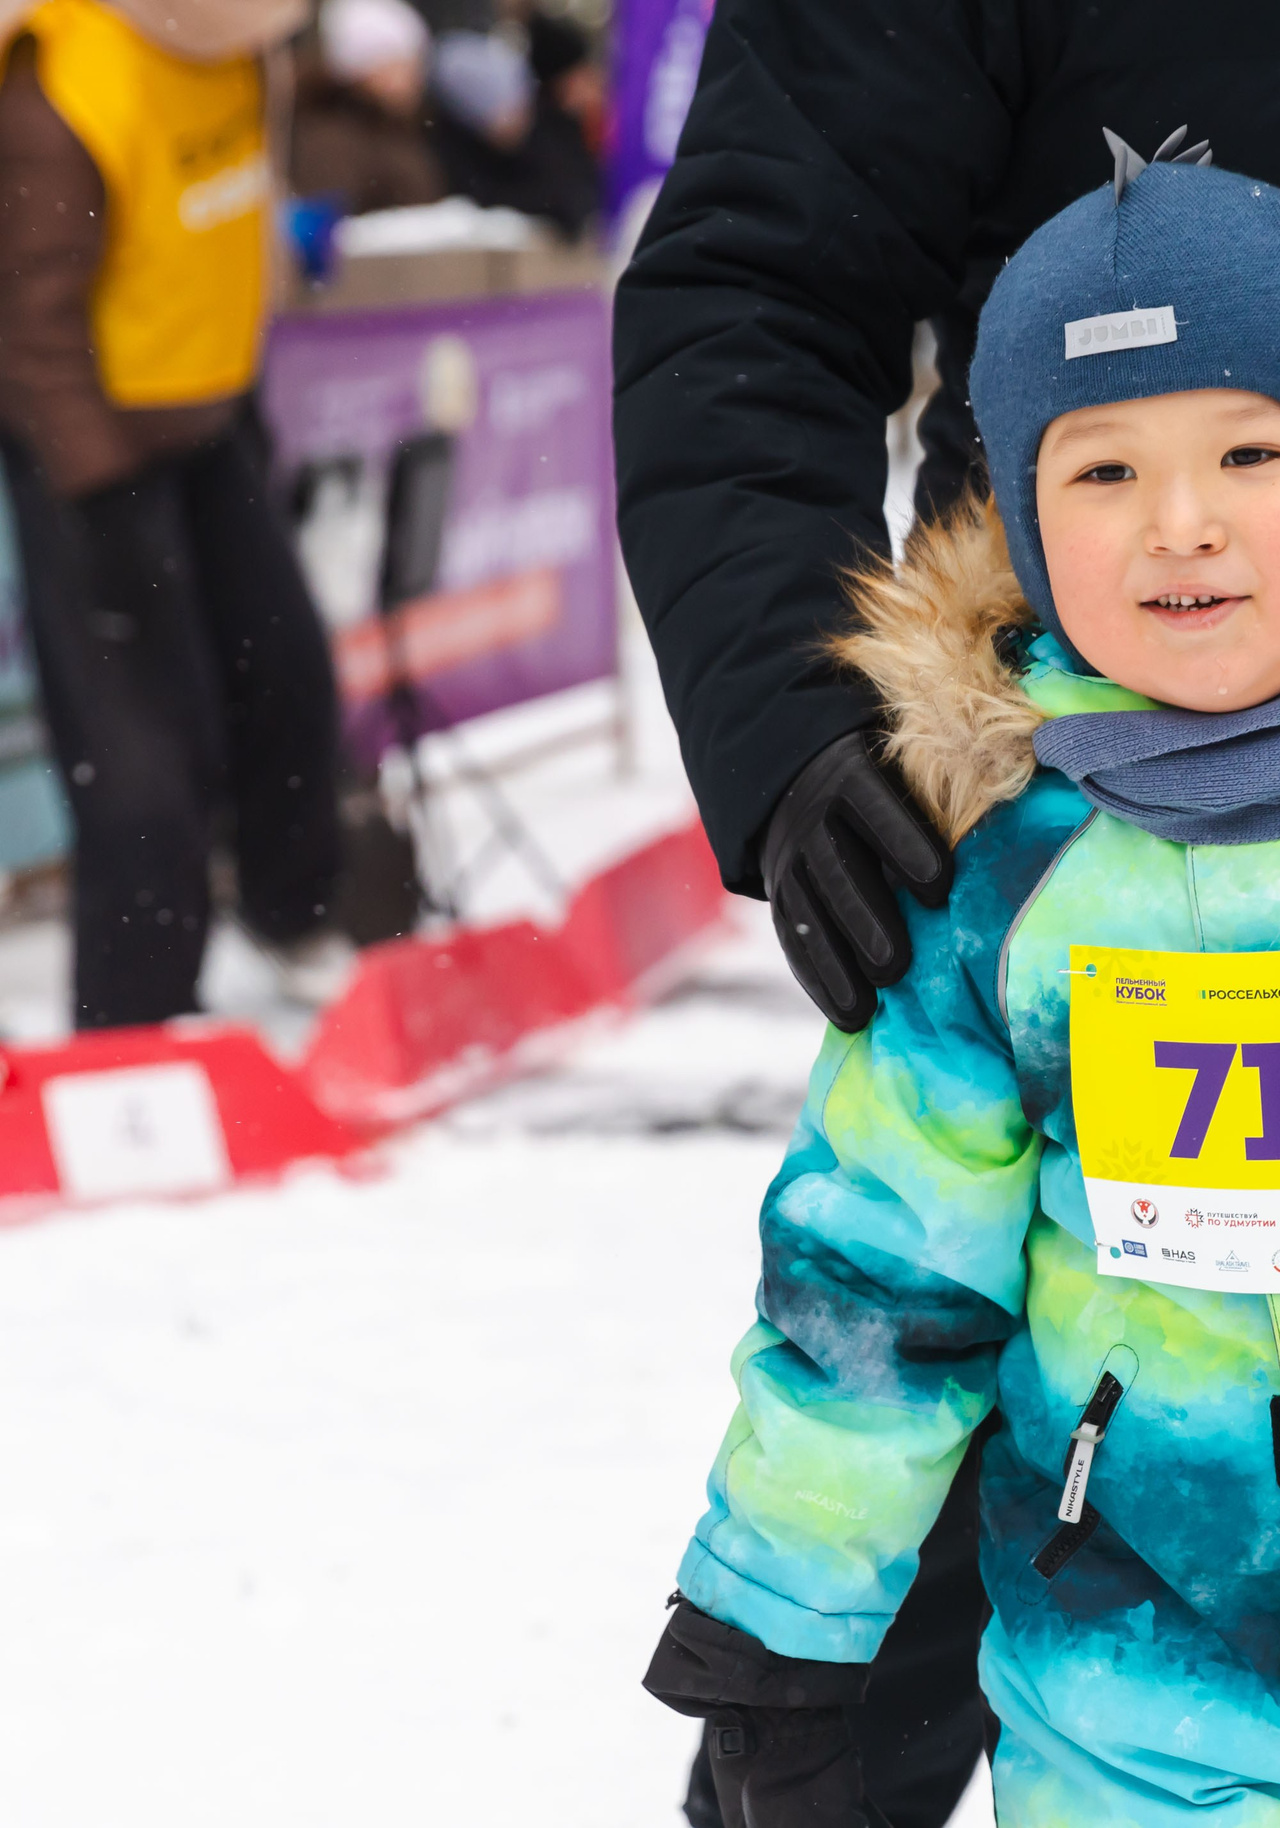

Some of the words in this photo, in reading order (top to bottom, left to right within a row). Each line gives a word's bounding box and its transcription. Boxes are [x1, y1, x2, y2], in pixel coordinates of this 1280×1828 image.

[1079, 317, 1158, 346] JUMBI
[1116, 977, 1166, 987] ПЕЛЬМЕННЫЙ
[1116, 986, 1167, 1001] КУБОК
[1208, 1218, 1220, 1226] ПО
[1224, 1219, 1276, 1228] УДМУРТИИ
[1171, 1249, 1196, 1261] HAS
[1065, 1459, 1085, 1517] NIKASTYLE
[794, 1489, 869, 1520] NIKASTYLE
